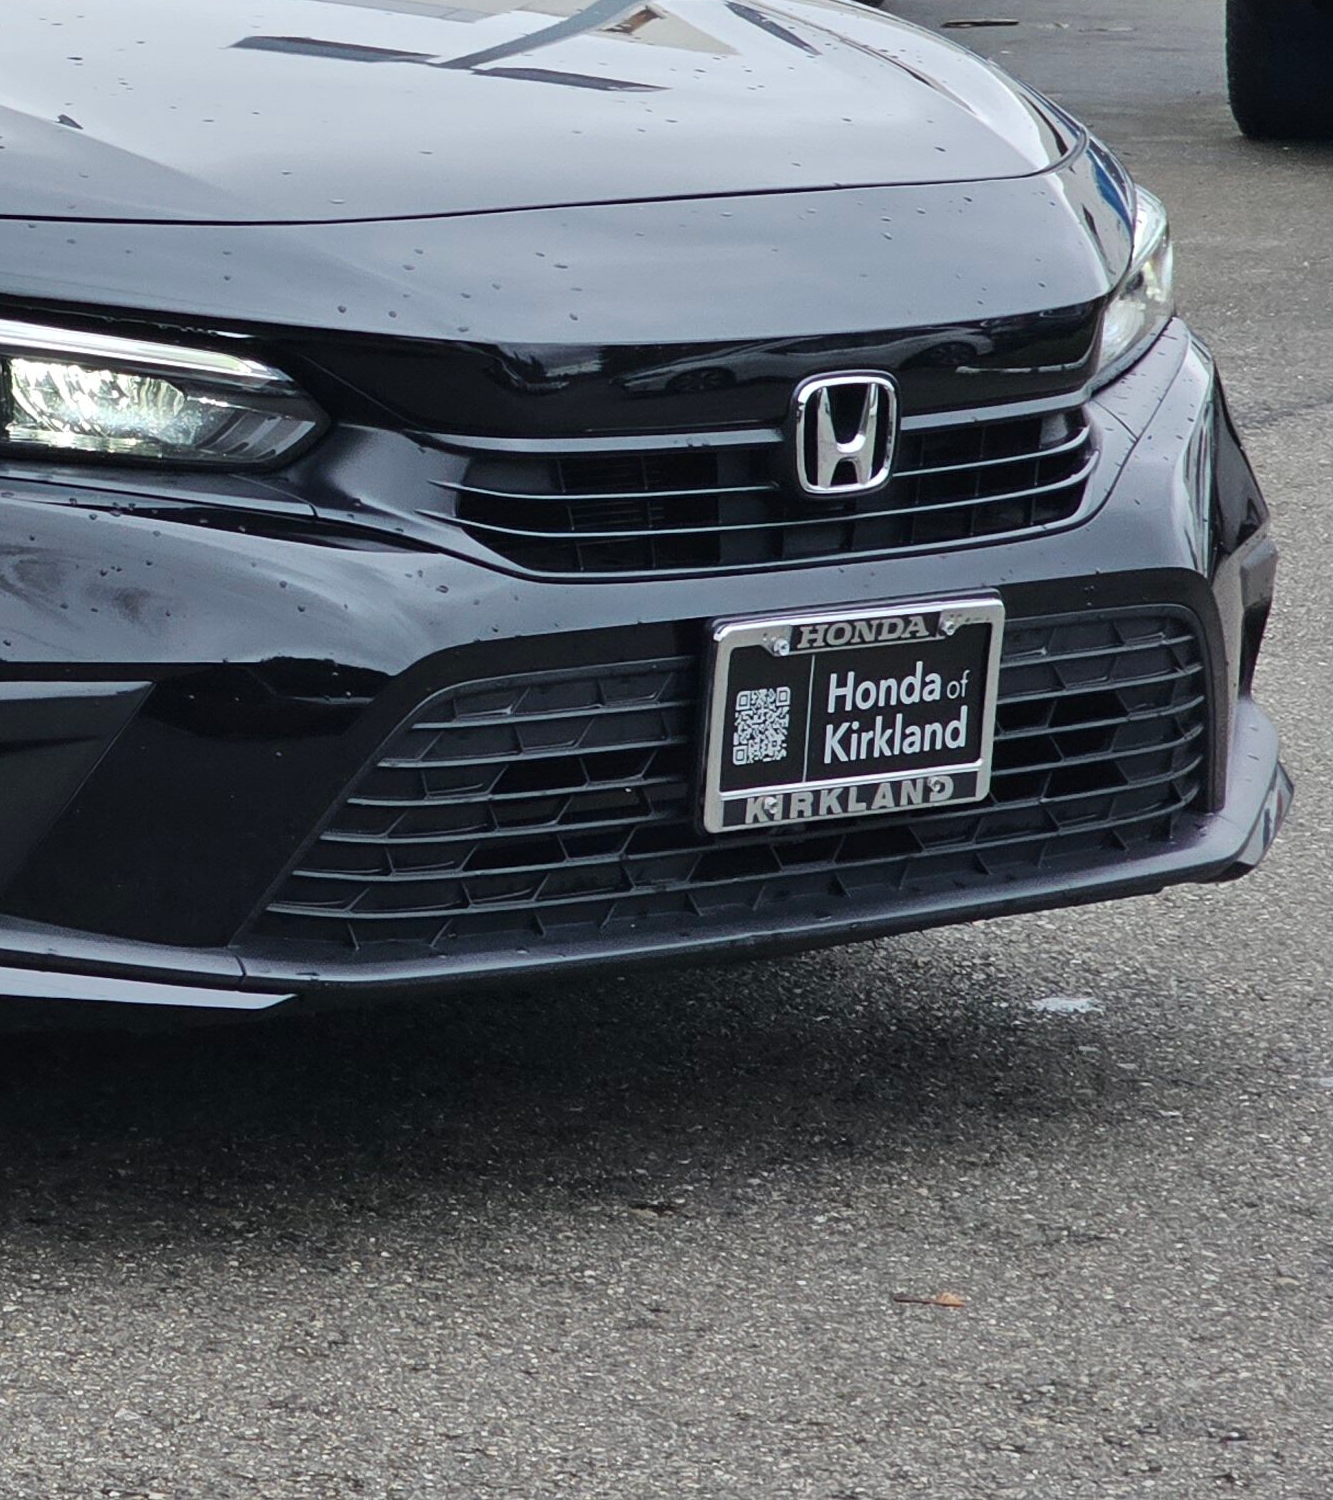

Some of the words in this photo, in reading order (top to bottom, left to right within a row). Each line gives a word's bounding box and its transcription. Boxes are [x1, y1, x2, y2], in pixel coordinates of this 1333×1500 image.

[797, 615, 929, 649] HONDA
[828, 661, 941, 713] Honda
[946, 670, 971, 700] of
[823, 706, 969, 764] Kirkland
[745, 775, 955, 825] KIRKLAND
